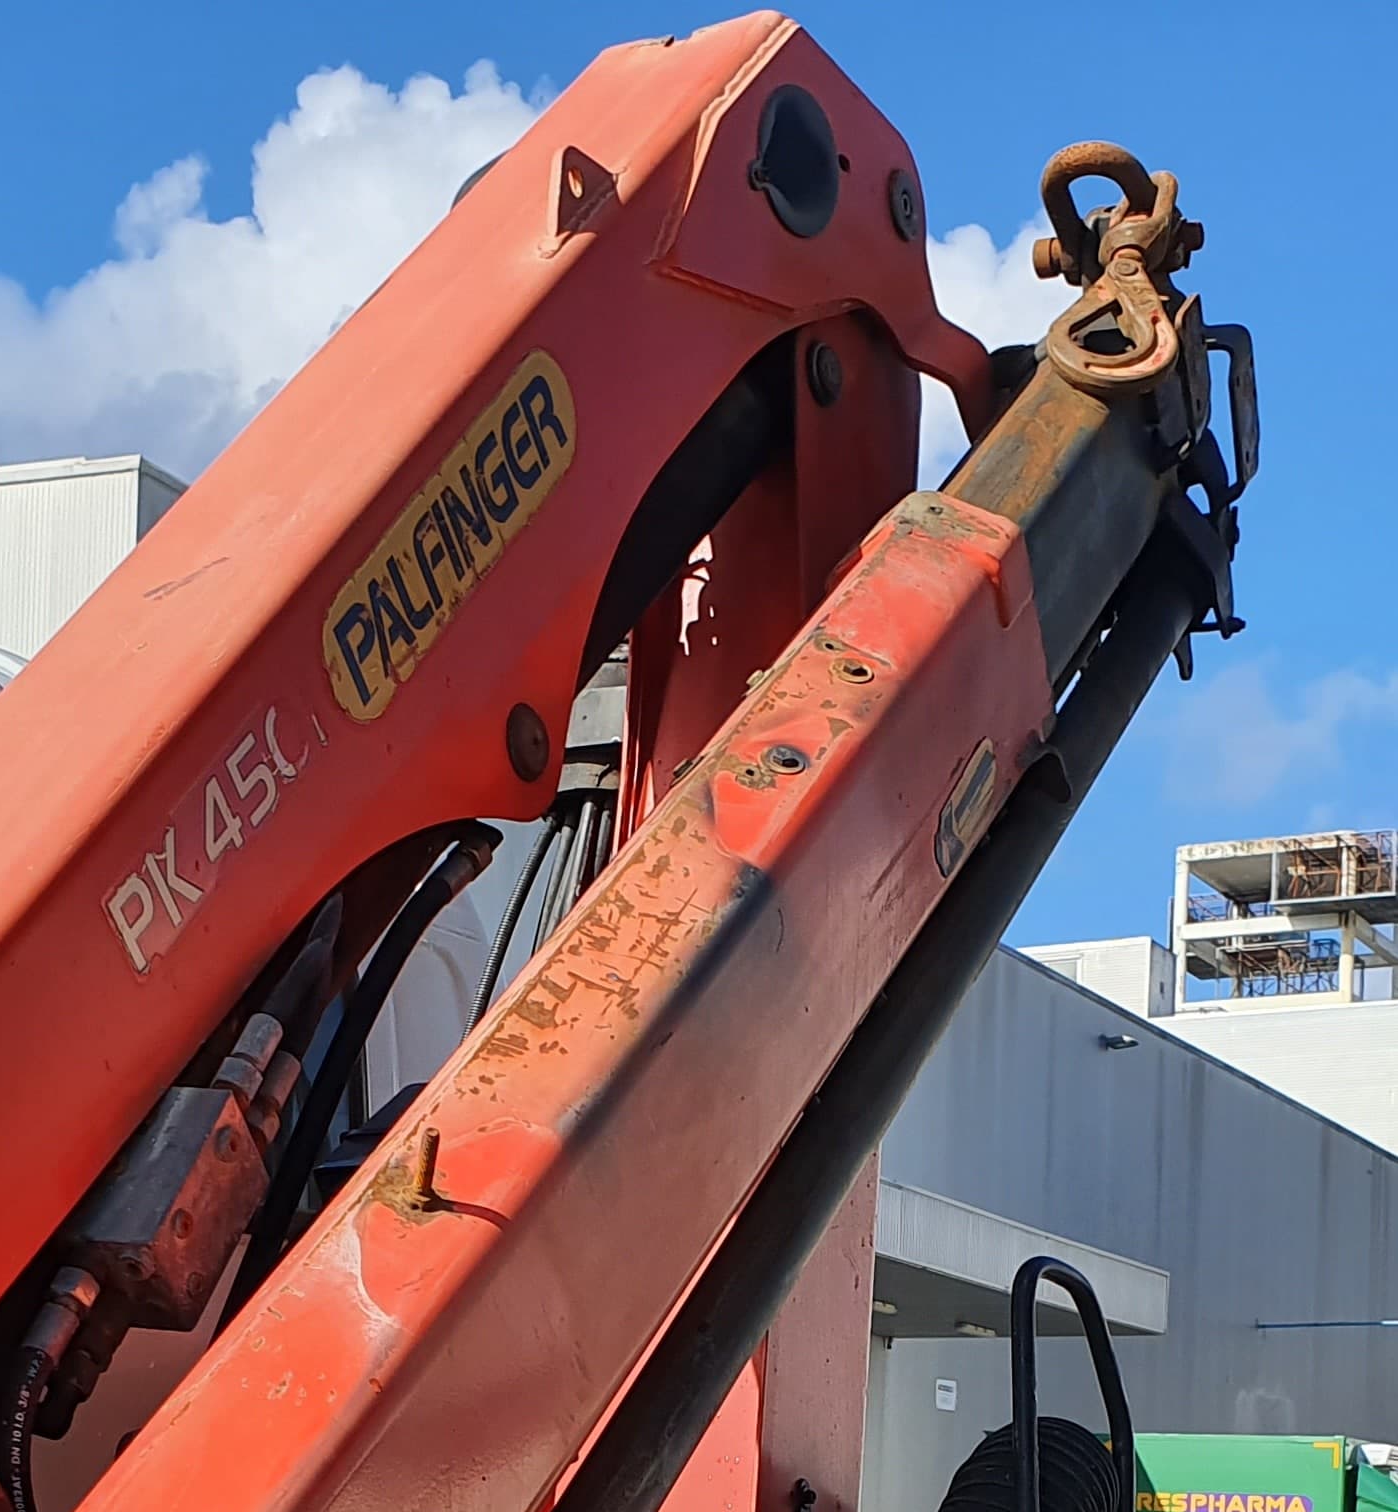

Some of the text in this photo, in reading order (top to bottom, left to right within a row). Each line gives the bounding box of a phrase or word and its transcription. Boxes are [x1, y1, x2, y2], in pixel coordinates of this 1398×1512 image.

[333, 375, 568, 706] PALFINGER
[107, 826, 204, 973] PK
[10, 1446, 21, 1465] DN
